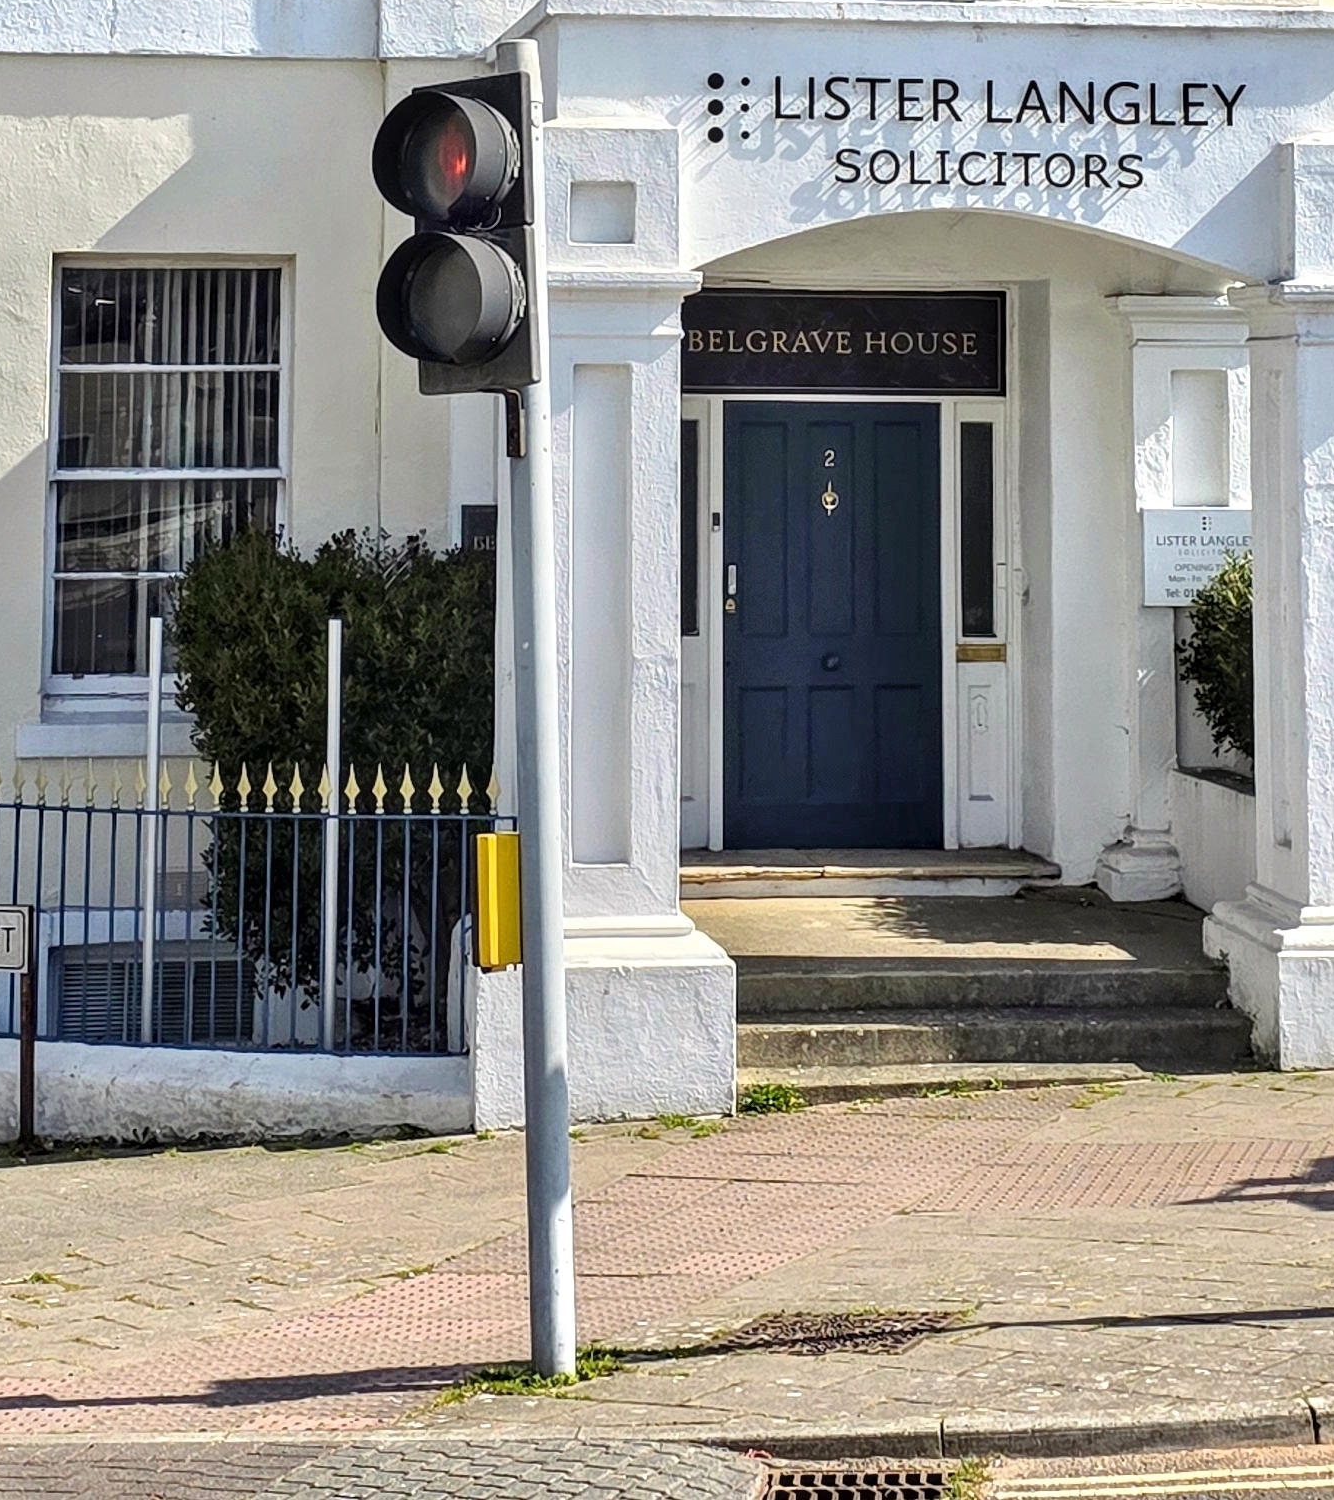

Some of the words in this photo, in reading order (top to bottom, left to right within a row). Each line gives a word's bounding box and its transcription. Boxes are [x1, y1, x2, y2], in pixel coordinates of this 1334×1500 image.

[774, 75, 962, 122] LISTER
[986, 78, 1247, 127] LANGLEY
[834, 148, 1144, 190] SOLICITORS
[687, 329, 852, 354] BELGRAVE
[864, 331, 978, 356] HOUSE
[824, 450, 835, 467] 2
[1156, 536, 1197, 547] LISTER
